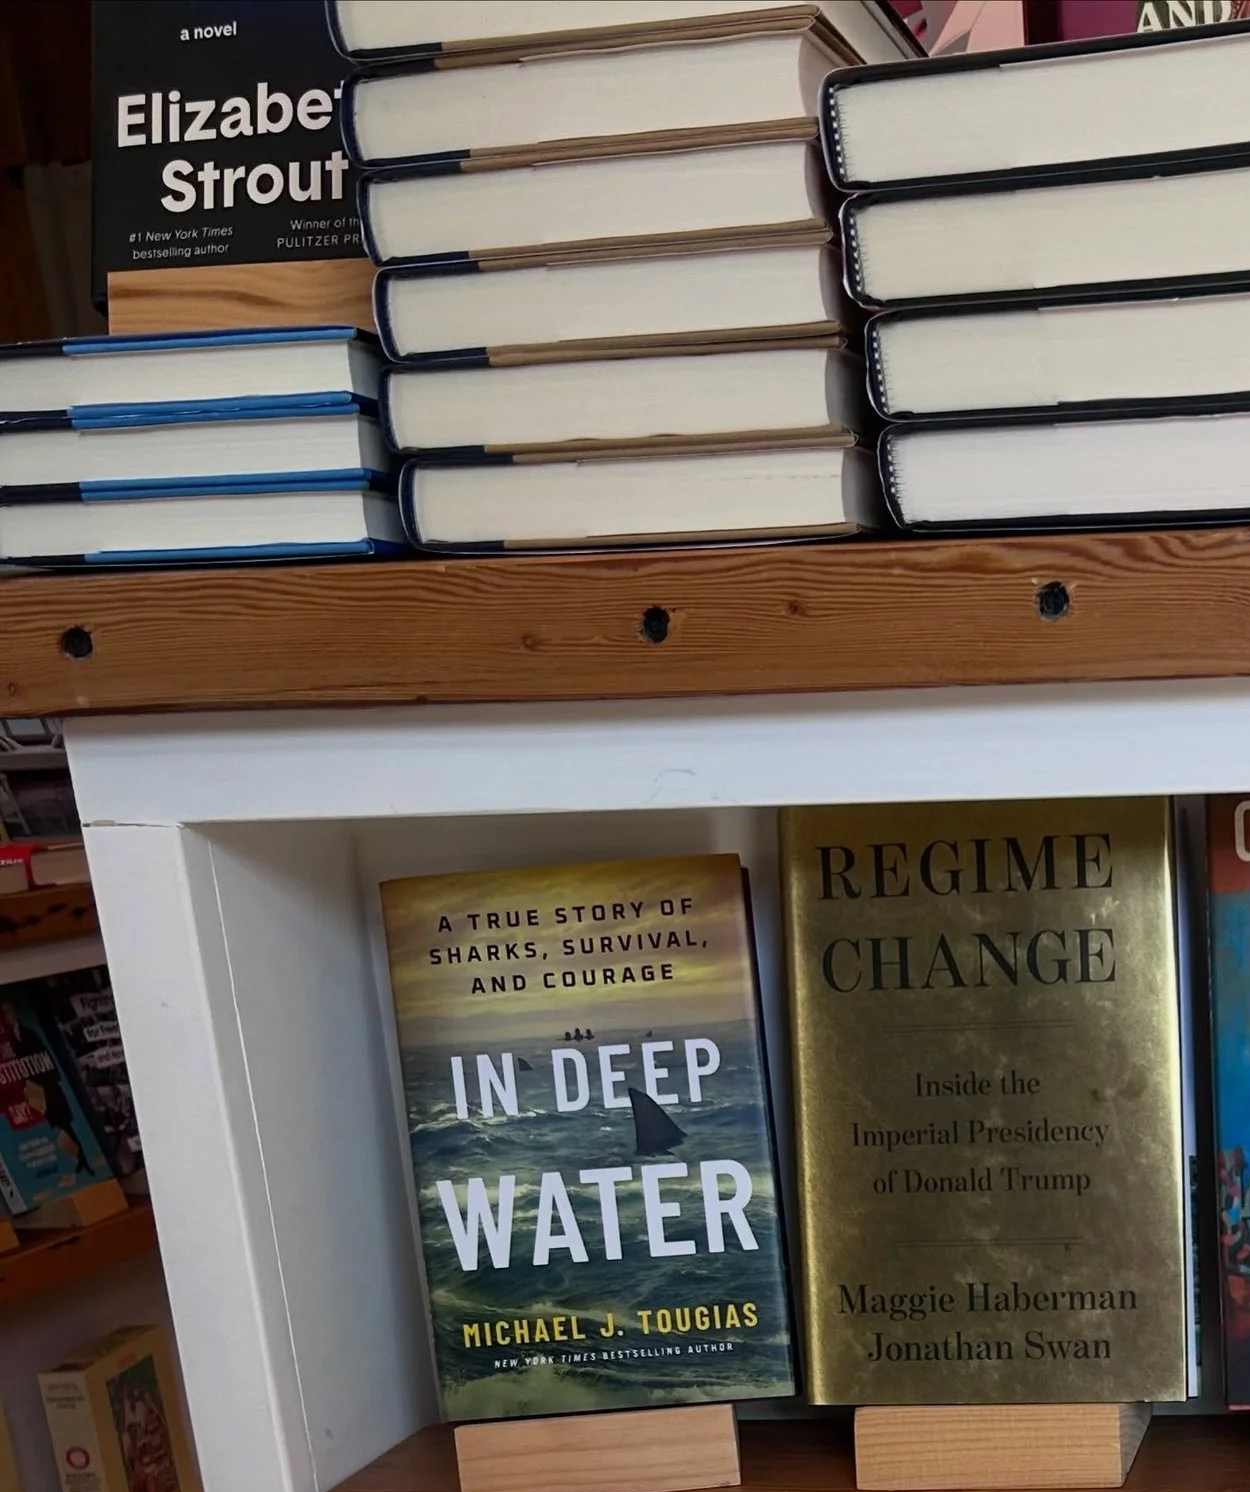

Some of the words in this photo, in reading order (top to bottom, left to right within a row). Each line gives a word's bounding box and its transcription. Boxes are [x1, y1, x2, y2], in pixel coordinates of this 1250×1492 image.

[180, 28, 190, 41] a
[194, 21, 237, 40] novel
[1137, 0, 1232, 33] AND
[118, 80, 344, 148] Elizabe
[161, 151, 349, 213] Strout
[129, 231, 142, 243] #1
[146, 230, 172, 242] New
[174, 228, 199, 241] York
[202, 225, 234, 238] Times
[290, 218, 330, 231] Winner
[333, 217, 347, 229] of
[132, 246, 191, 260] bestselling
[194, 242, 230, 256] author
[277, 235, 339, 249] PULITZER
[814, 833, 1114, 901] REGIME
[438, 915, 452, 932] A
[467, 908, 540, 931] TRUE
[555, 901, 644, 924] STORY
[660, 898, 693, 916] OF
[429, 940, 549, 965] SHARKS,
[563, 929, 708, 956] SURVIVAL,
[822, 928, 1116, 993] CHANGE
[471, 974, 527, 995] AND
[543, 963, 674, 989] COURAGE
[451, 1053, 518, 1119] IN
[552, 1037, 721, 1113] DEEP
[916, 1072, 992, 1098] Inside
[1001, 1070, 1041, 1095] the
[852, 1119, 958, 1152] Imperial
[968, 1117, 1110, 1147] Presidency
[873, 1169, 899, 1194] of
[904, 1167, 992, 1193] Donald
[1000, 1166, 1091, 1195] Trump
[436, 1159, 759, 1272] WATER
[838, 1284, 955, 1321] Maggie
[965, 1282, 1138, 1312] Haberman
[463, 1316, 586, 1348] MICHAEL
[600, 1313, 625, 1337] J.
[637, 1303, 759, 1336] TOUGIAS
[494, 1357, 521, 1370] NEW
[525, 1354, 555, 1367] YORK
[561, 1351, 597, 1363] TIMES
[603, 1346, 682, 1361] BESTSELLING
[688, 1342, 734, 1354] AUTHOR
[867, 1331, 1014, 1363] Jonathan
[1024, 1330, 1112, 1361] Swan
